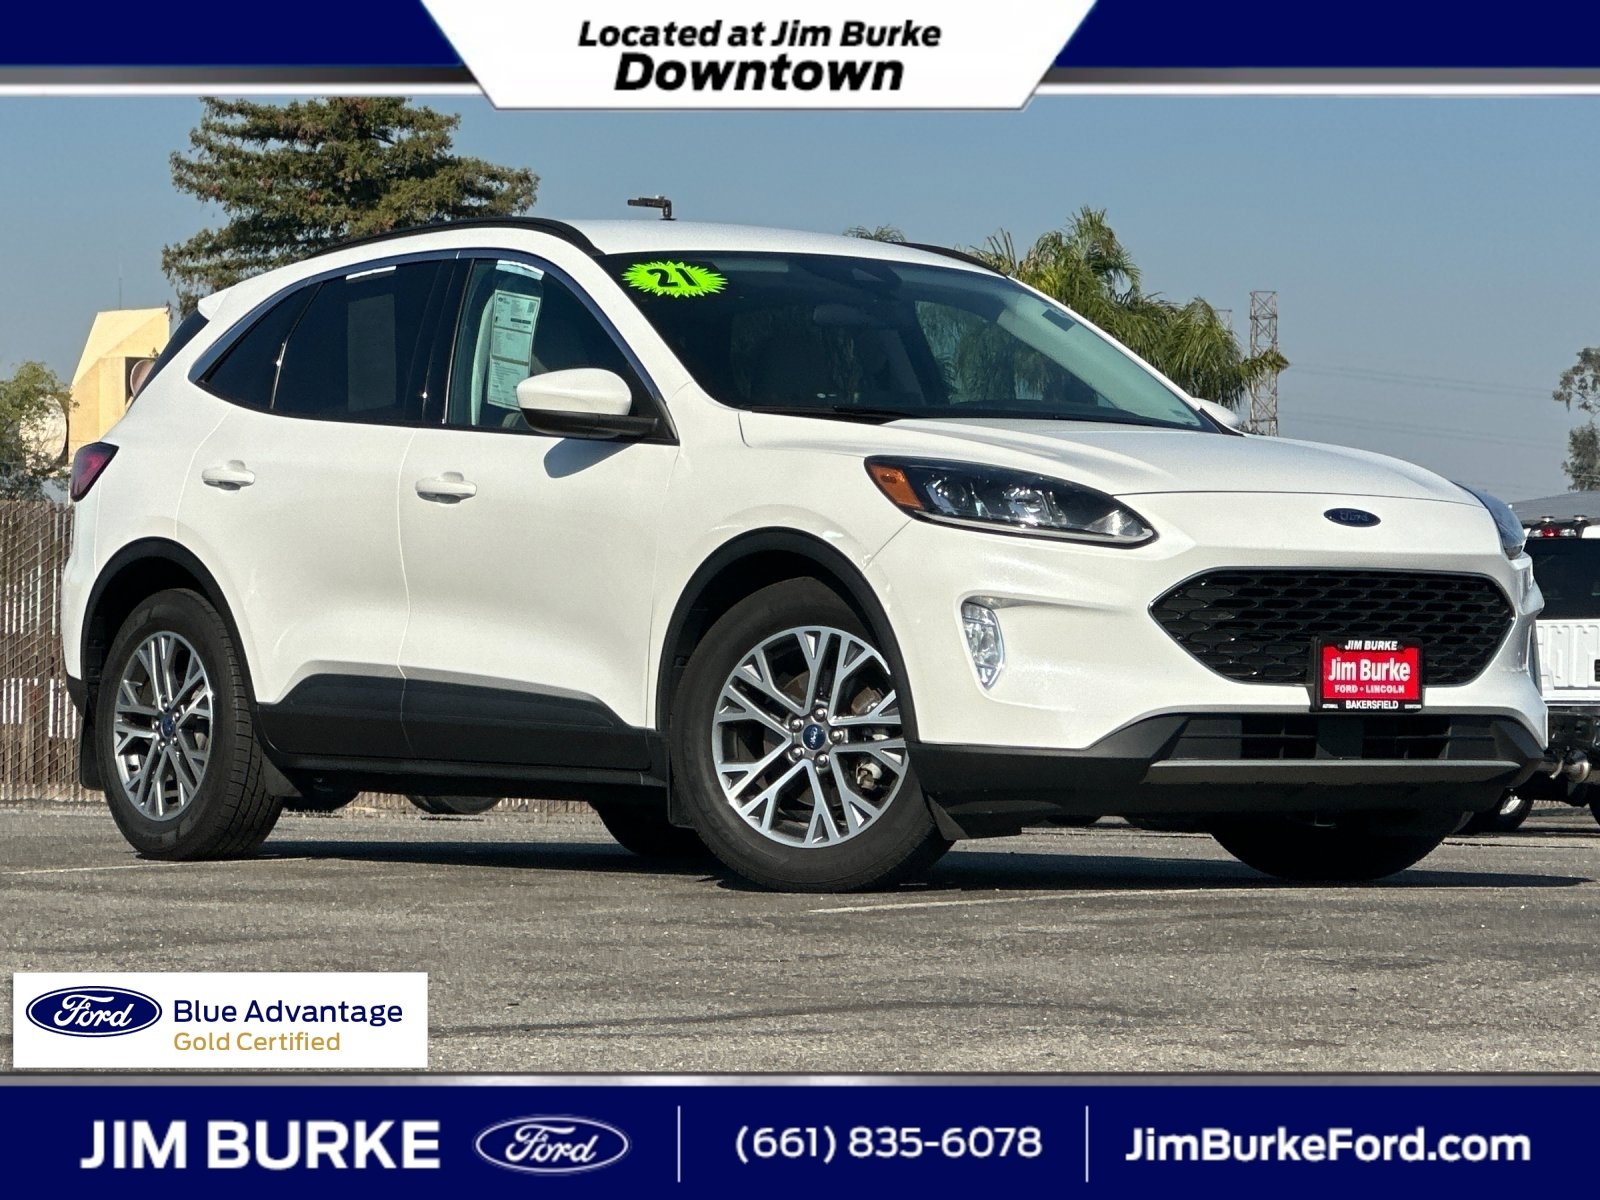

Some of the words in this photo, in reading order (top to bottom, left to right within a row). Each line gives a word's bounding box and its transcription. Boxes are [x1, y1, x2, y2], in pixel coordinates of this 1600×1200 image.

[646, 267, 700, 288] 21
[1344, 640, 1362, 651] JIM
[1364, 640, 1398, 651] BURKE
[1328, 656, 1357, 681] Jim
[1360, 657, 1411, 682] Burke
[1334, 684, 1358, 693] FORD
[1365, 684, 1405, 694] LINCOLN
[1345, 700, 1399, 709] BAKERSFIELD
